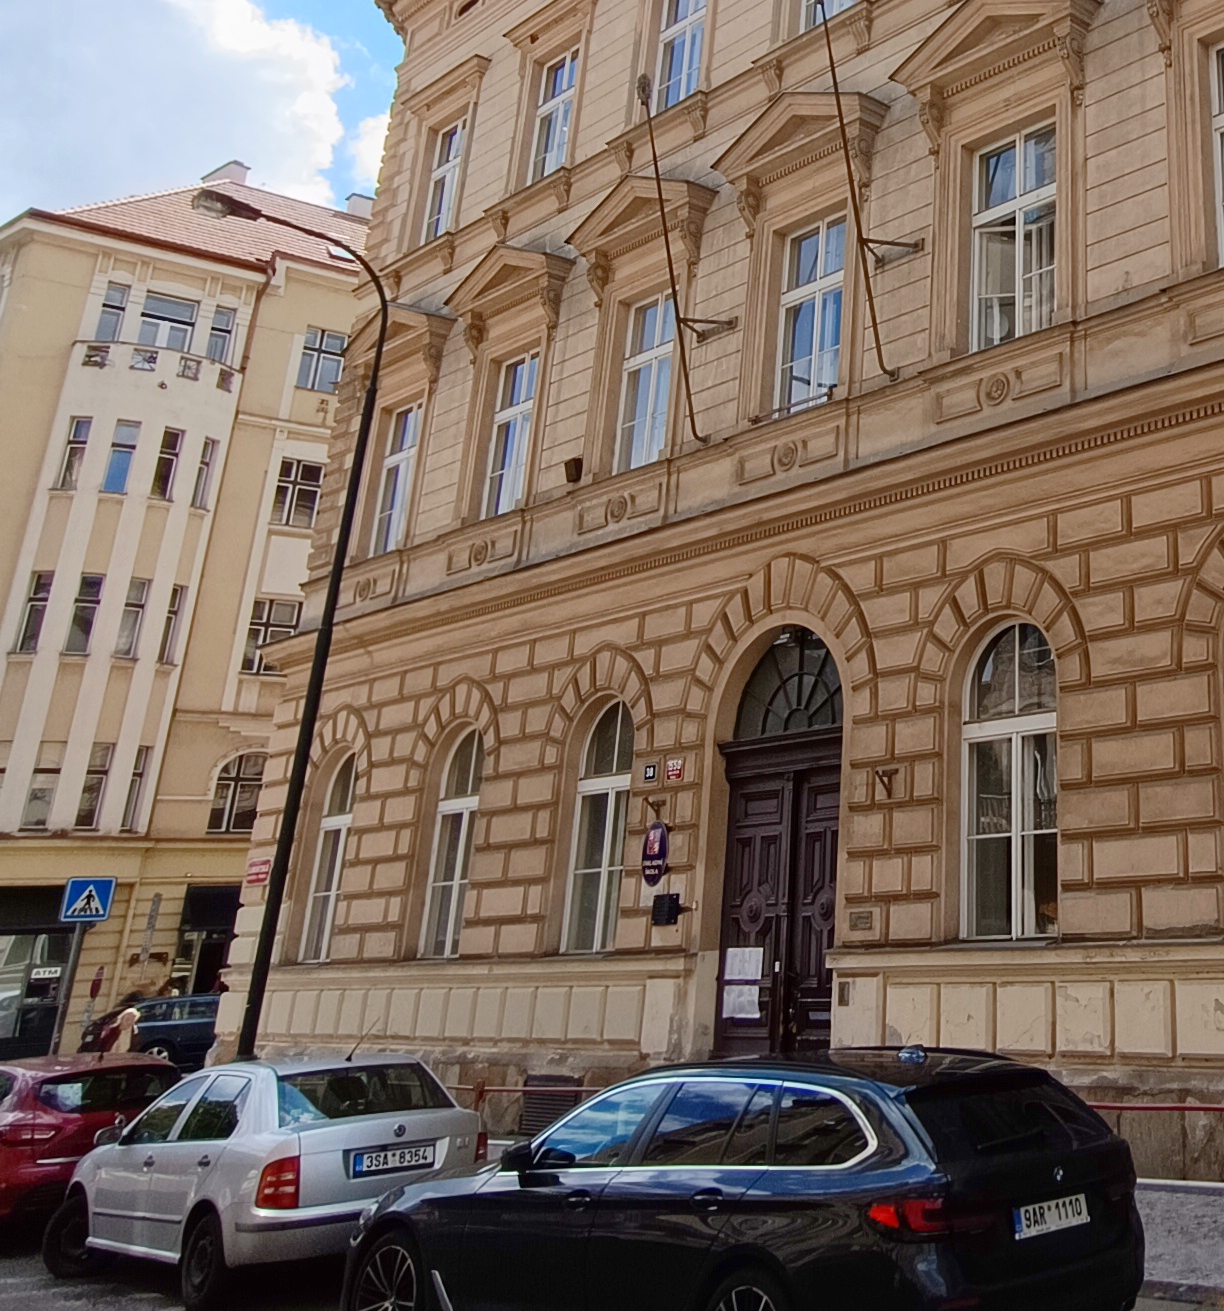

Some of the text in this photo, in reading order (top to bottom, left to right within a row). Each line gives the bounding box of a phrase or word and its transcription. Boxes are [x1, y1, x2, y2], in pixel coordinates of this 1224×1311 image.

[34, 969, 59, 977] ATM
[366, 1148, 428, 1169] 3SA 8354
[1024, 1205, 1047, 1229] 9AR
[1055, 1197, 1082, 1221] 1110
